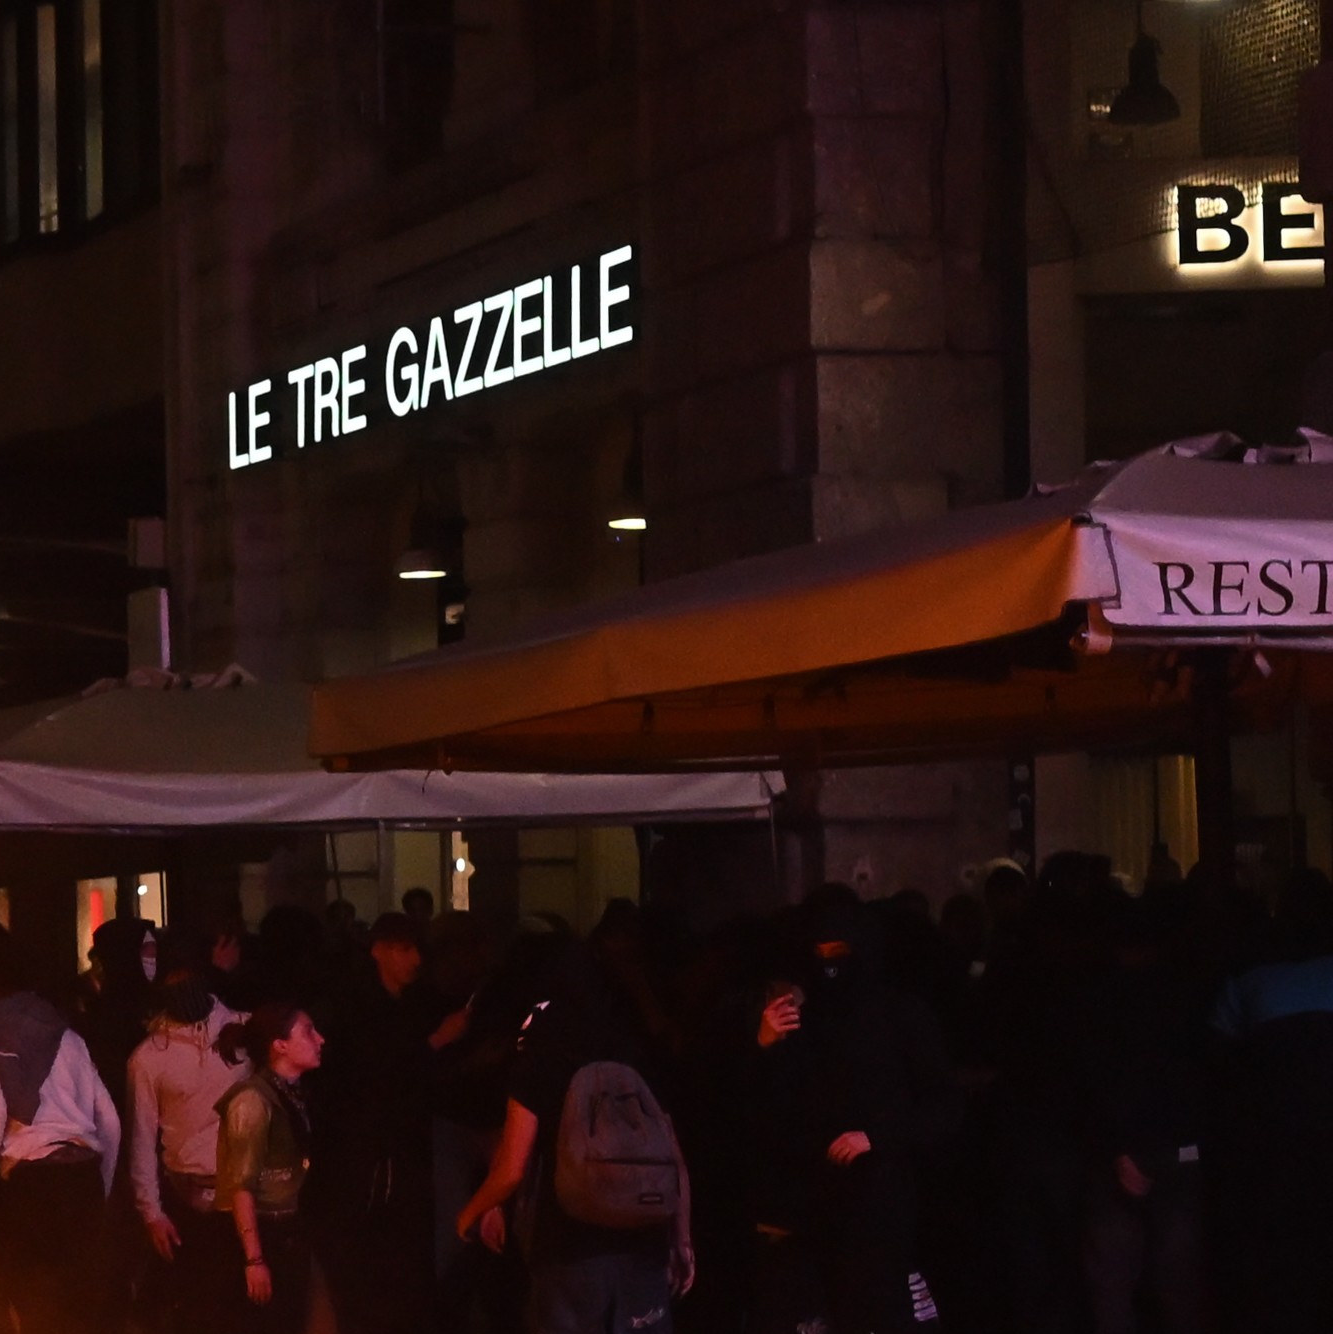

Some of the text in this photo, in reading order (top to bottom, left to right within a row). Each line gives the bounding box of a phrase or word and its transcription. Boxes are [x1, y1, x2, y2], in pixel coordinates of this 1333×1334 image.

[1177, 182, 1325, 265] BE
[229, 244, 633, 470] LE TRE GAZZELLE
[1152, 559, 1333, 616] REST
